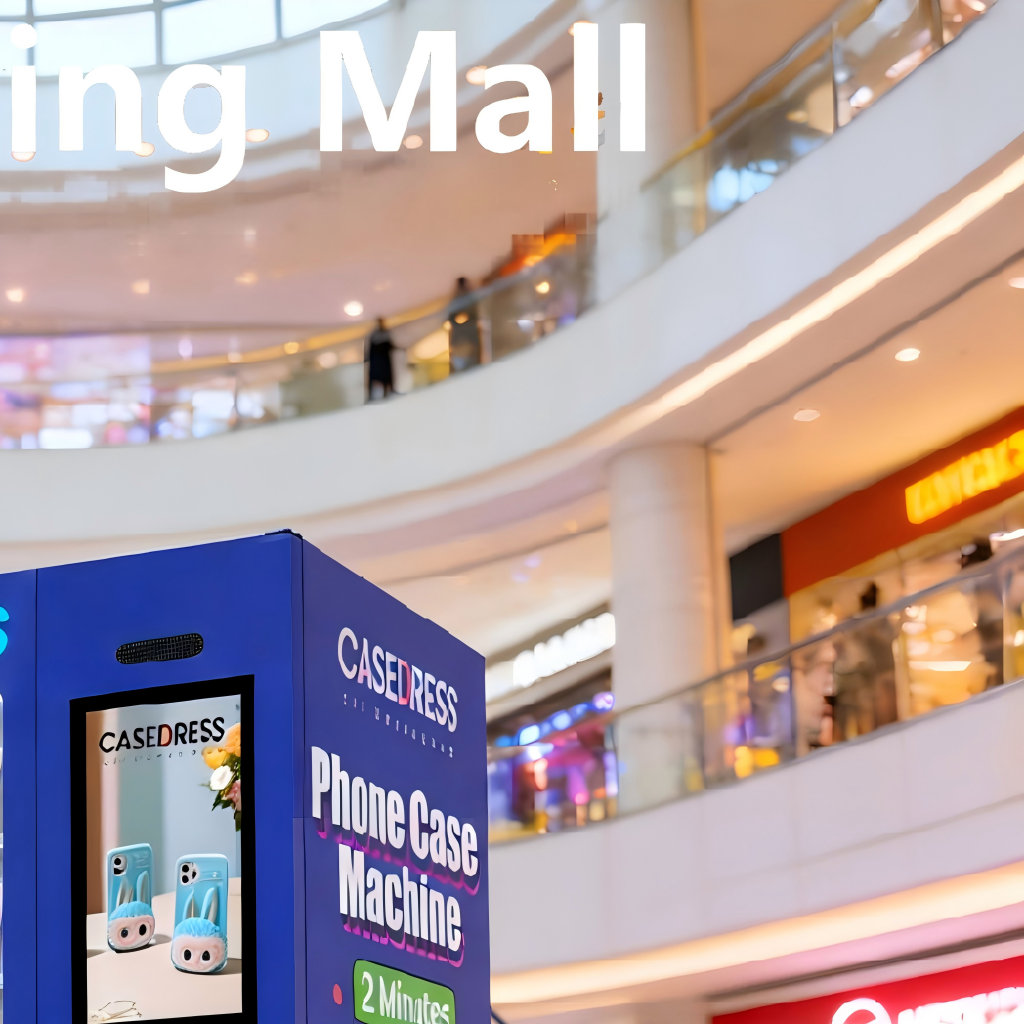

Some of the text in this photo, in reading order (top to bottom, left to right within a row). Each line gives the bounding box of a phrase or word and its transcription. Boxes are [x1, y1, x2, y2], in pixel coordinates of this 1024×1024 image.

[337, 627, 458, 732] CASEDRESS
[98, 716, 225, 753] CASEDRESS
[311, 746, 478, 876] Phone Case
[338, 843, 461, 952] Machine
[361, 971, 375, 1014] 2
